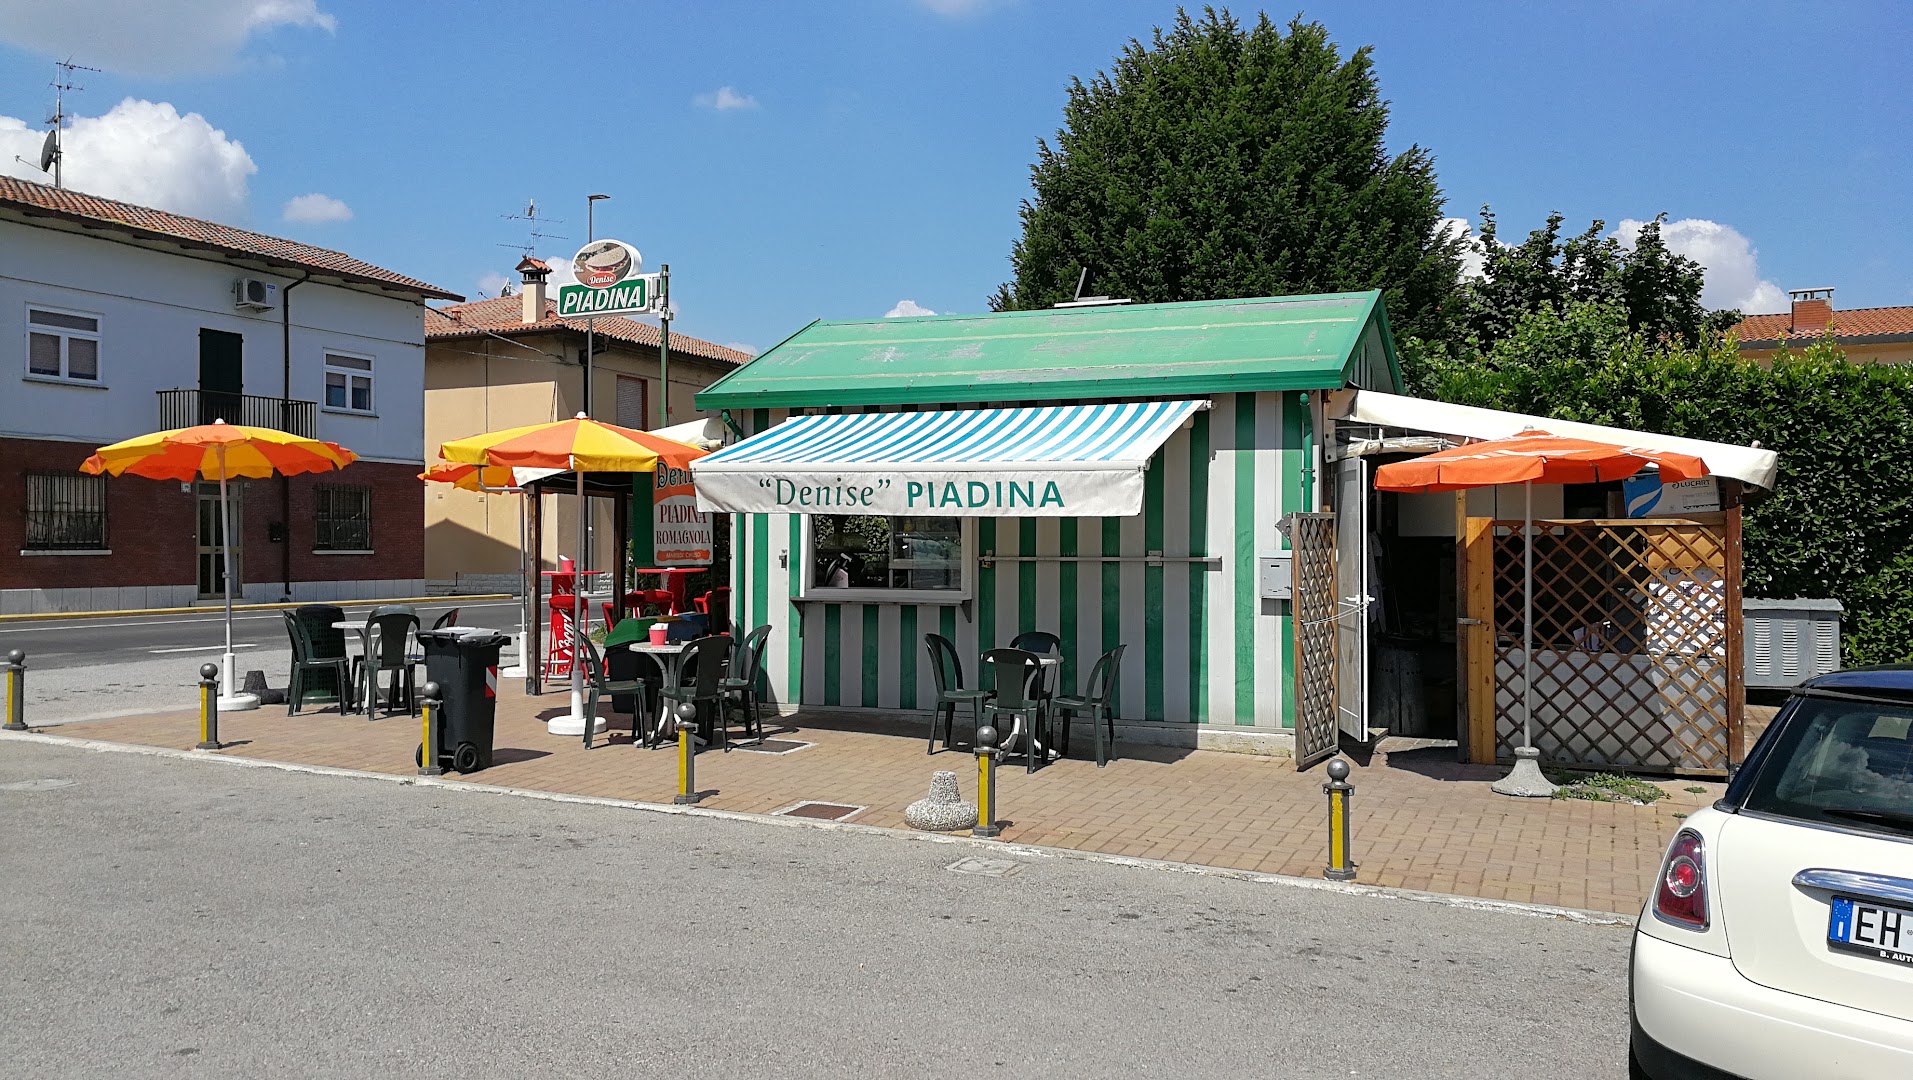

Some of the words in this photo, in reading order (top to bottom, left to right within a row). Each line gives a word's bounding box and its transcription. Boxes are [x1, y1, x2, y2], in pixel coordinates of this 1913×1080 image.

[563, 286, 641, 313] PIADINA
[656, 461, 694, 490] Deni
[1680, 480, 1710, 488] LUCART
[907, 481, 1066, 508] PIADINA
[659, 504, 707, 524] PIADINA
[656, 530, 711, 545] ROMAGNOLA
[1855, 907, 1902, 948] EH
[1880, 950, 1889, 958] B.
